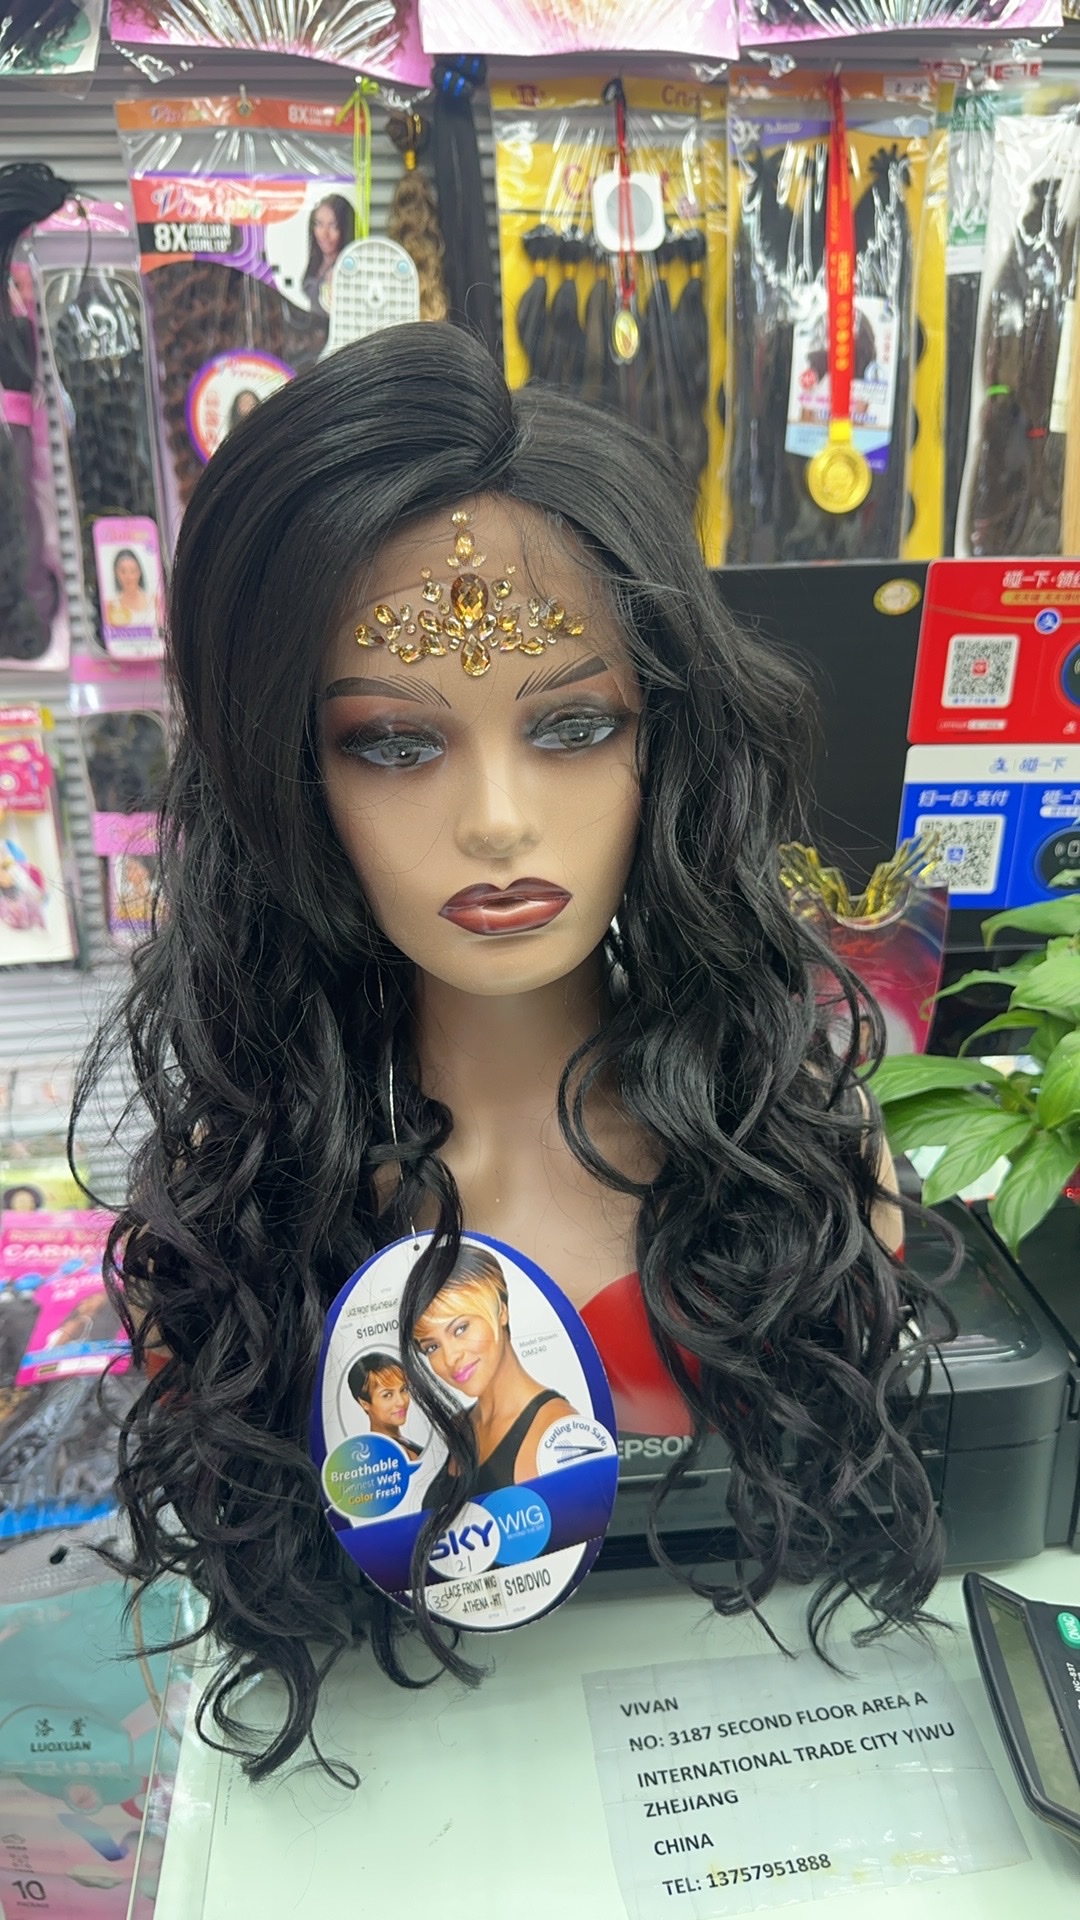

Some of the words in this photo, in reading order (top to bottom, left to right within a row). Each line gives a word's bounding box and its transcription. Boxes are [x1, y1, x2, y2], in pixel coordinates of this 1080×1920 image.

[154, 223, 187, 252] 8X
[519, 1338, 537, 1348] Model
[521, 1345, 547, 1358] OM240
[544, 1423, 572, 1449] Curling
[572, 1421, 591, 1432] Iron
[591, 1427, 607, 1447] Safe
[331, 1457, 399, 1483] Breathable
[376, 1471, 402, 1485] Weft
[348, 1493, 374, 1505] Color
[375, 1484, 402, 1499] Fresh
[498, 1504, 545, 1534] WIG
[429, 1519, 494, 1561] SKY
[461, 1578, 484, 1596] FRONT
[484, 1575, 498, 1589] WIG
[504, 1568, 551, 1597] S1B/DVIO
[620, 1697, 679, 1717] VIVAN
[629, 1734, 665, 1752] NO:
[668, 1726, 712, 1747] 3187
[717, 1713, 793, 1738] SECOND
[795, 1704, 858, 1725] FLOOR
[861, 1695, 911, 1715] AREA
[914, 1691, 928, 1706] A
[30, 1741, 92, 1753] LUOXUAN
[636, 1752, 793, 1788] INTERNATIONAL
[793, 1739, 857, 1763] TRADE
[860, 1731, 899, 1751] CITY
[902, 1722, 955, 1744] YIWU
[643, 1789, 739, 1818] ZHEJIANG
[653, 1832, 715, 1856] CHINA
[662, 1876, 702, 1896] TEL:
[706, 1853, 832, 1889] 13757951888
[11, 1880, 47, 1901] 10
